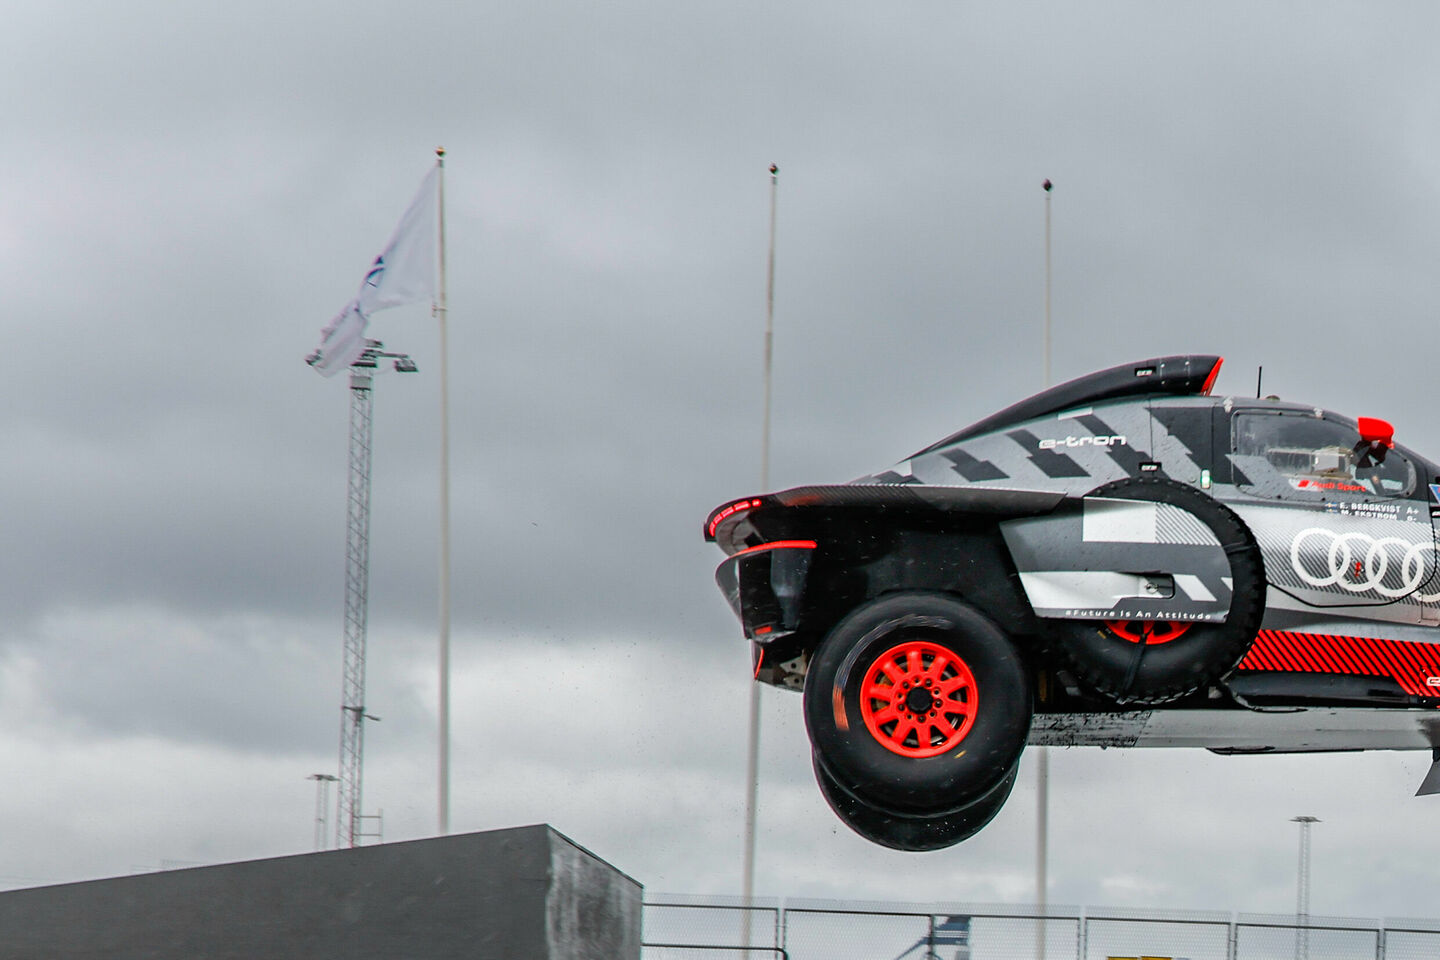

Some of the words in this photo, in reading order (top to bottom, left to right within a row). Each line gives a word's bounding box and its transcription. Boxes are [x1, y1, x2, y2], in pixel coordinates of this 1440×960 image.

[1039, 435, 1128, 449] e-tron
[1311, 480, 1335, 489] Audi
[1337, 482, 1366, 493] Sport
[1351, 502, 1401, 514] BERGKVIST
[1135, 610, 1152, 618] An
[1156, 611, 1212, 620] Attitude
